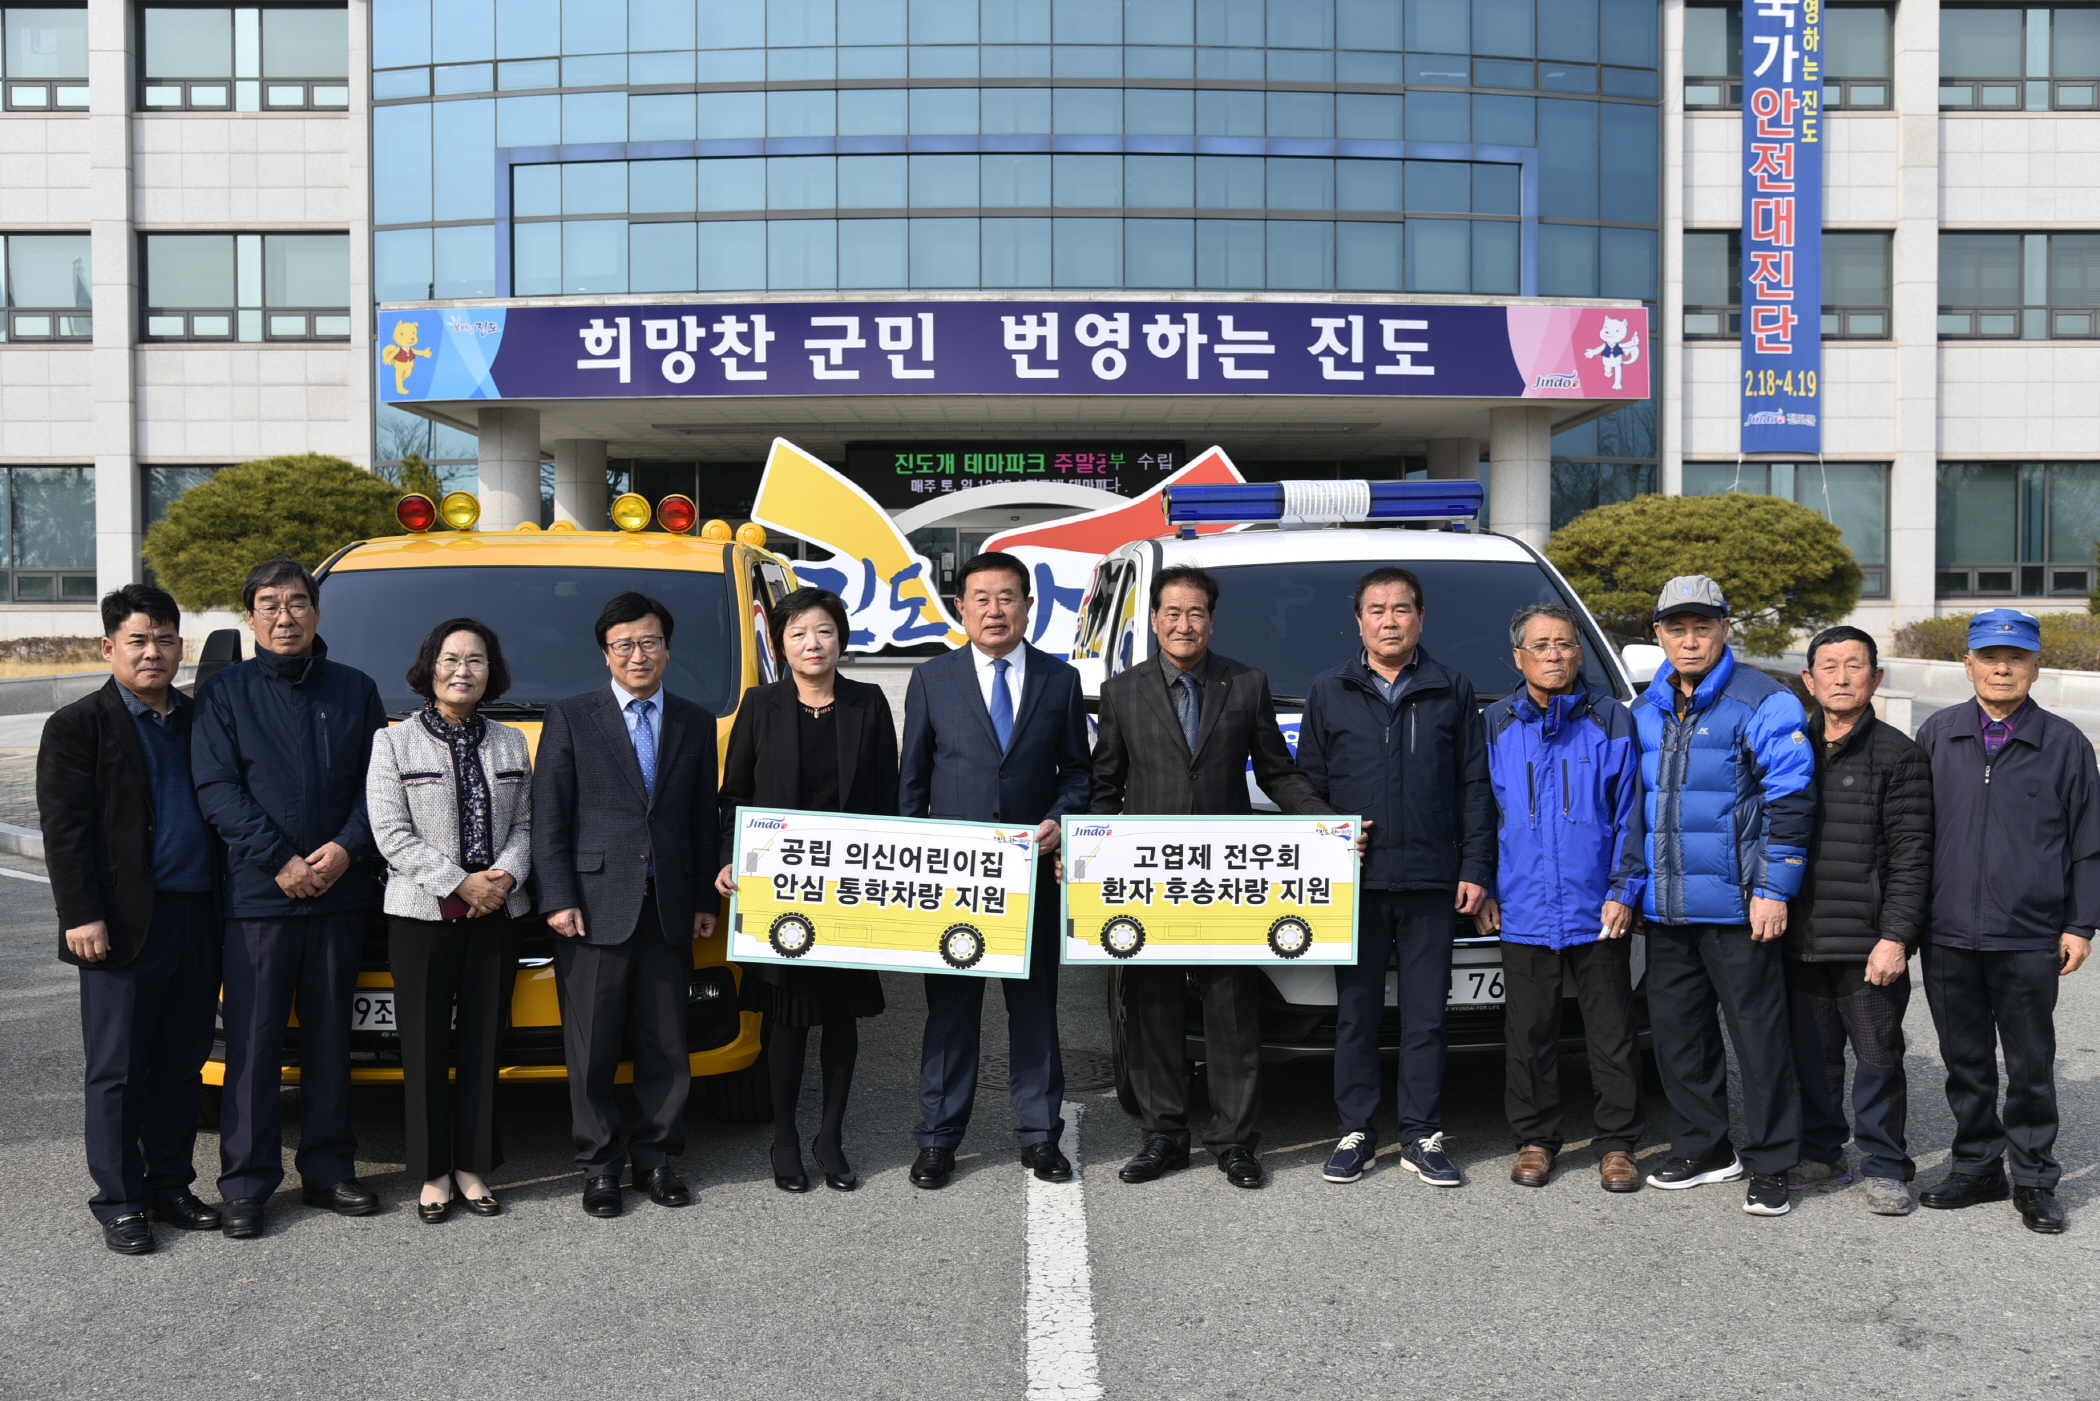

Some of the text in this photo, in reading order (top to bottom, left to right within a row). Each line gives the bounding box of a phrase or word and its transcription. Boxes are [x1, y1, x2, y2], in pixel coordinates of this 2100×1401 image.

[1801, 90, 1819, 143] 진도
[1748, 87, 1800, 354] 안전대진단
[475, 321, 502, 337] 진도
[577, 312, 1435, 384] 희망찬 군민 번영하는 진도
[1532, 376, 1572, 388] Jindo
[895, 453, 955, 475] 진도개
[964, 453, 1046, 475] 테마파크
[1137, 452, 1173, 471] 수립
[911, 479, 936, 493] 매주
[746, 818, 781, 829] Jindo
[1072, 827, 1106, 837] Jindo
[780, 838, 1004, 878] 공립 의신어린이집
[1133, 843, 1300, 870] 고엽제 전우회
[773, 873, 1006, 914] 안심 통학차량 지원
[1101, 877, 1330, 905] 환자 후송차량 지원
[1468, 971, 1505, 999] 76
[354, 997, 394, 1025] 9조
